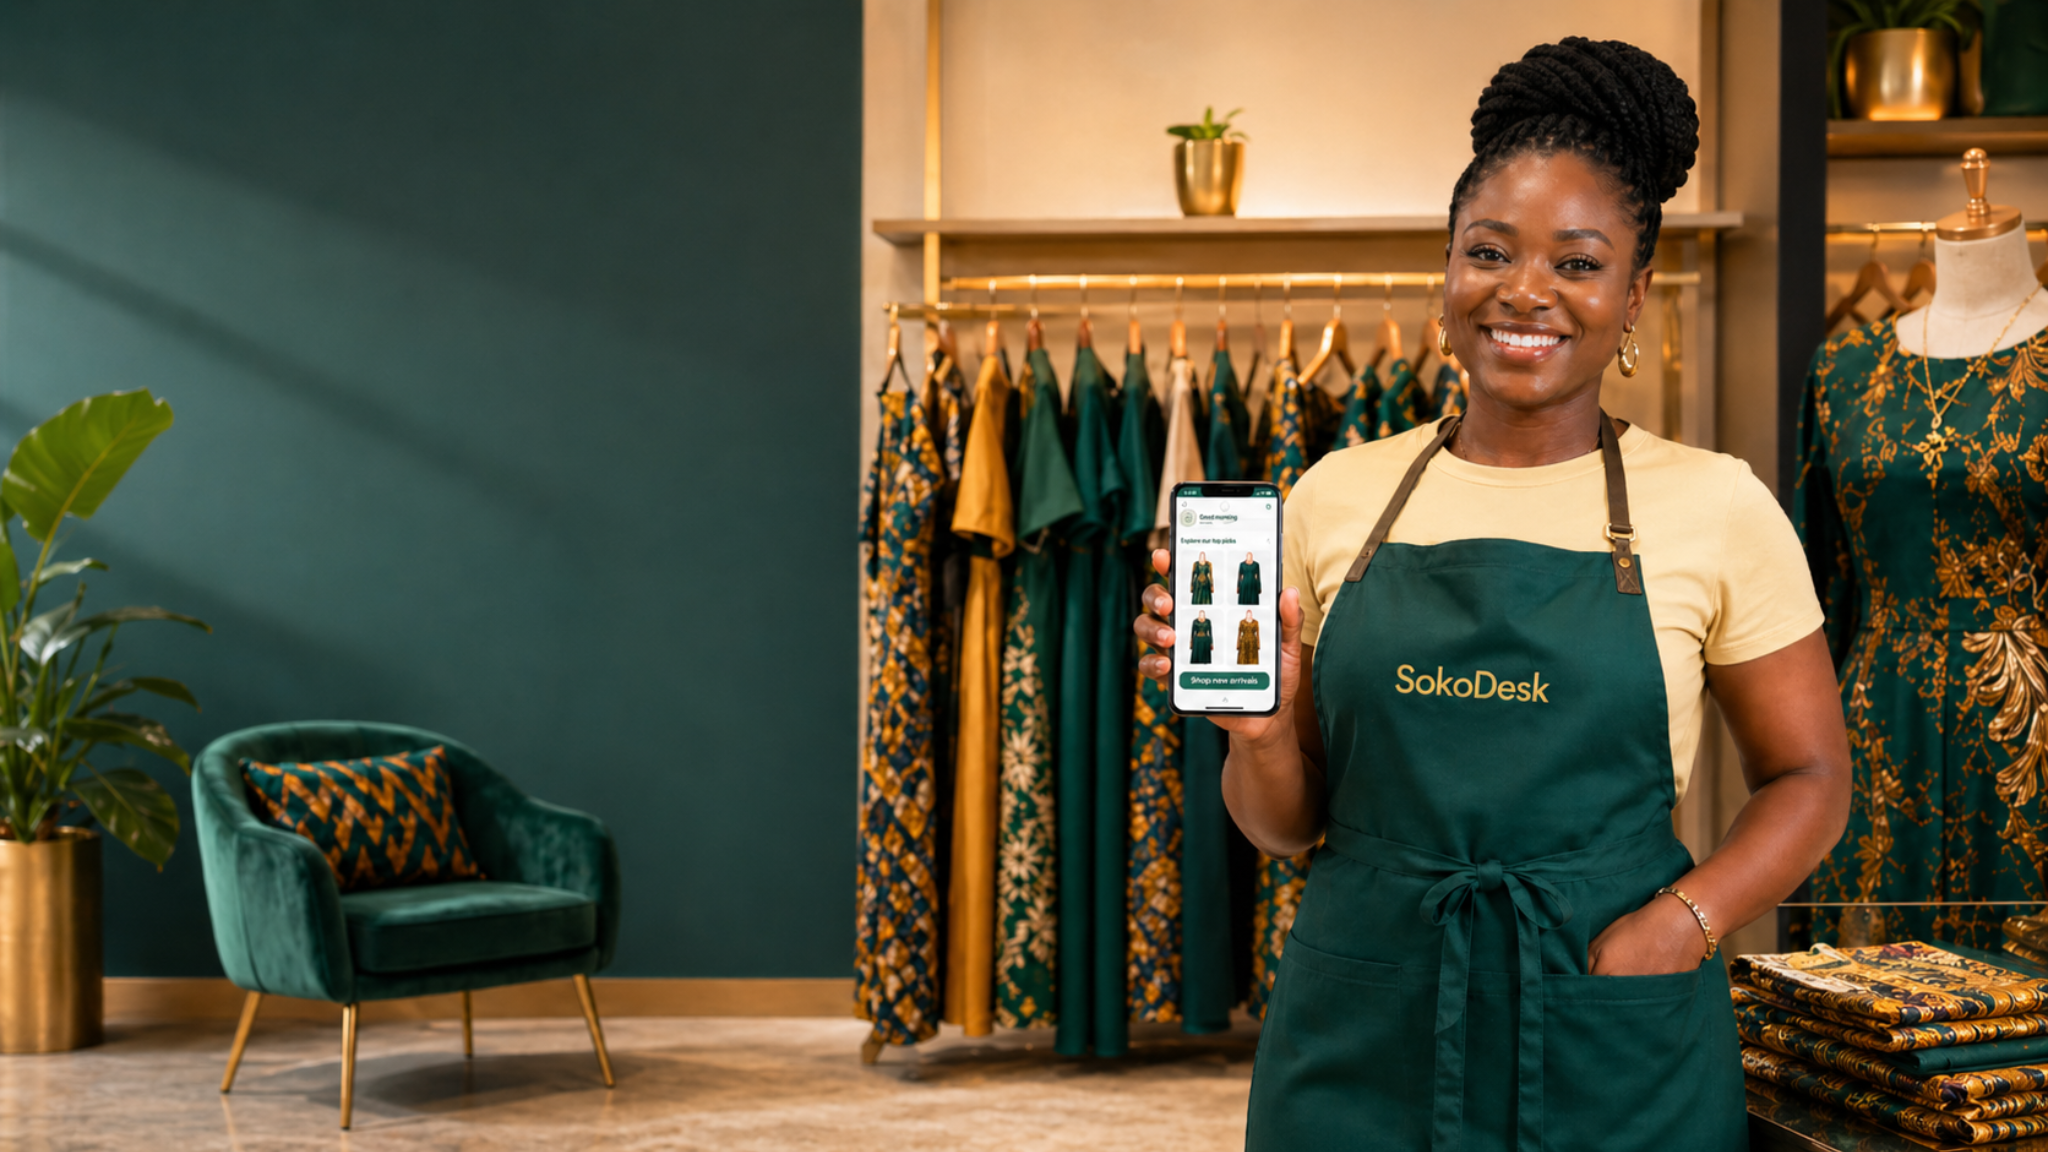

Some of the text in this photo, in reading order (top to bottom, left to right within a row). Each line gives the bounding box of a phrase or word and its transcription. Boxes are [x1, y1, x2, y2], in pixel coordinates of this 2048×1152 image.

[1190, 676, 1211, 685] Shop
[1230, 676, 1258, 684] arrivals
[1395, 664, 1550, 703] SokoDesk
